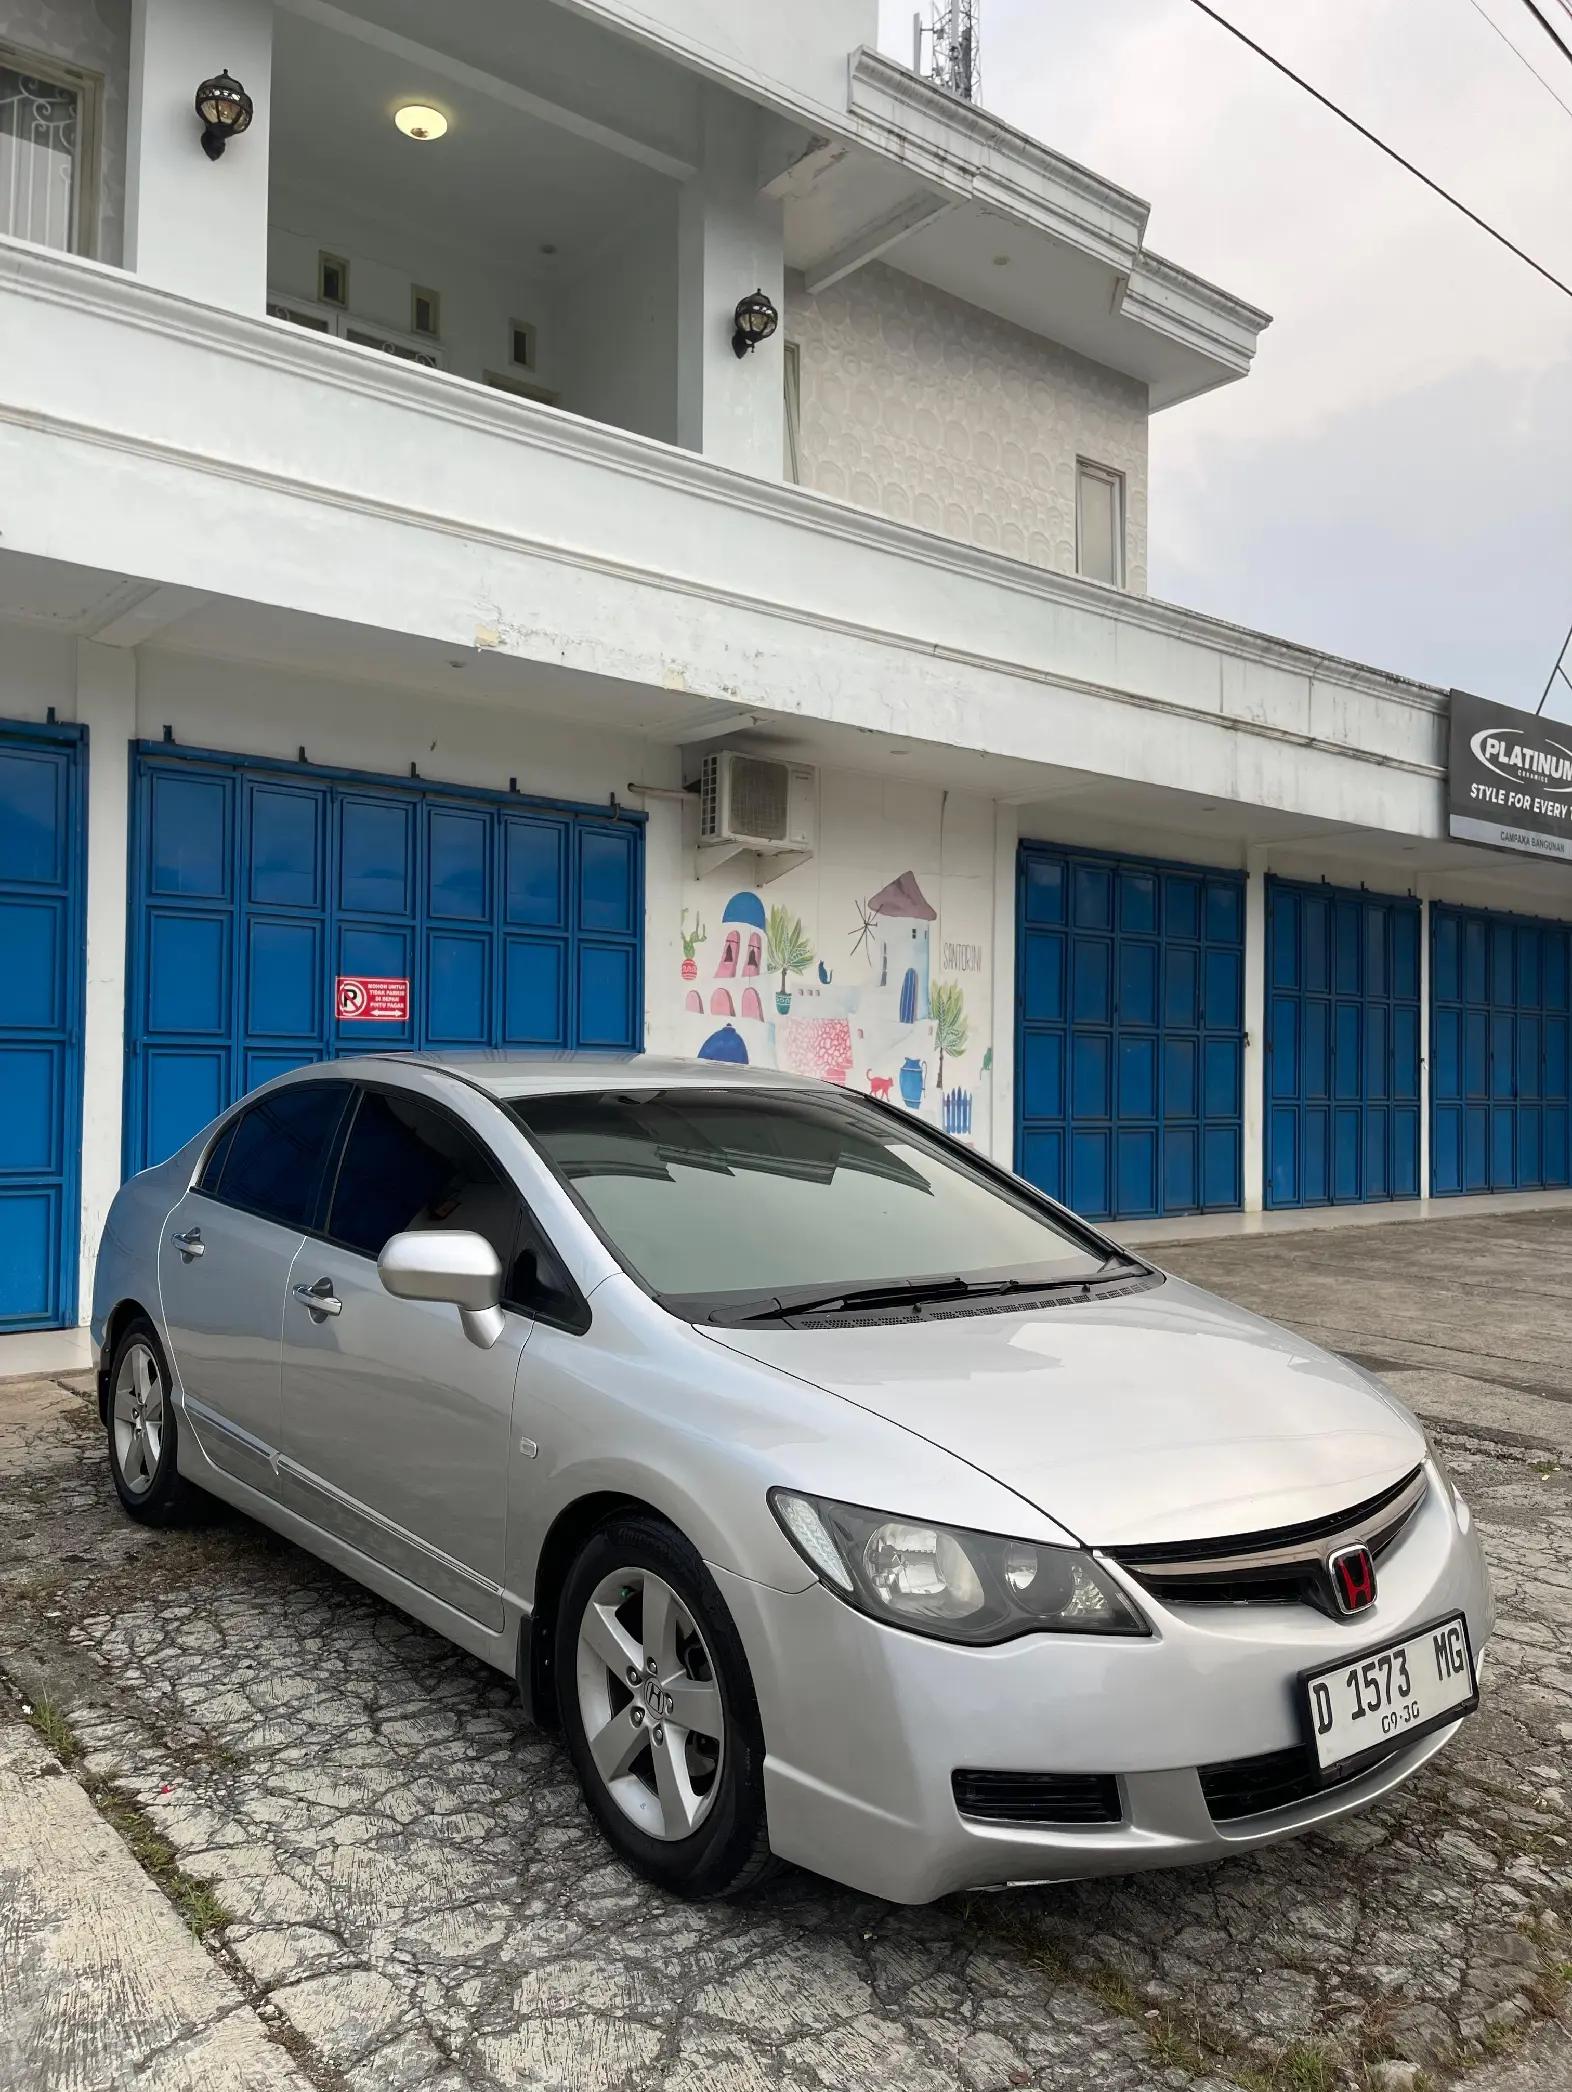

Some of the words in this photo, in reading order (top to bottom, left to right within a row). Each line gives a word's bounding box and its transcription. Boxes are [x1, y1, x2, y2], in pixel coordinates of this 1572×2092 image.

[1485, 737, 1572, 782] PLATINUM
[1470, 782, 1506, 805] STYLE
[1508, 791, 1531, 811] FOR
[1533, 797, 1568, 819] EVERY
[1313, 1682, 1333, 1735] D
[1346, 1649, 1411, 1721] 1573
[1433, 1627, 1464, 1681] MG
